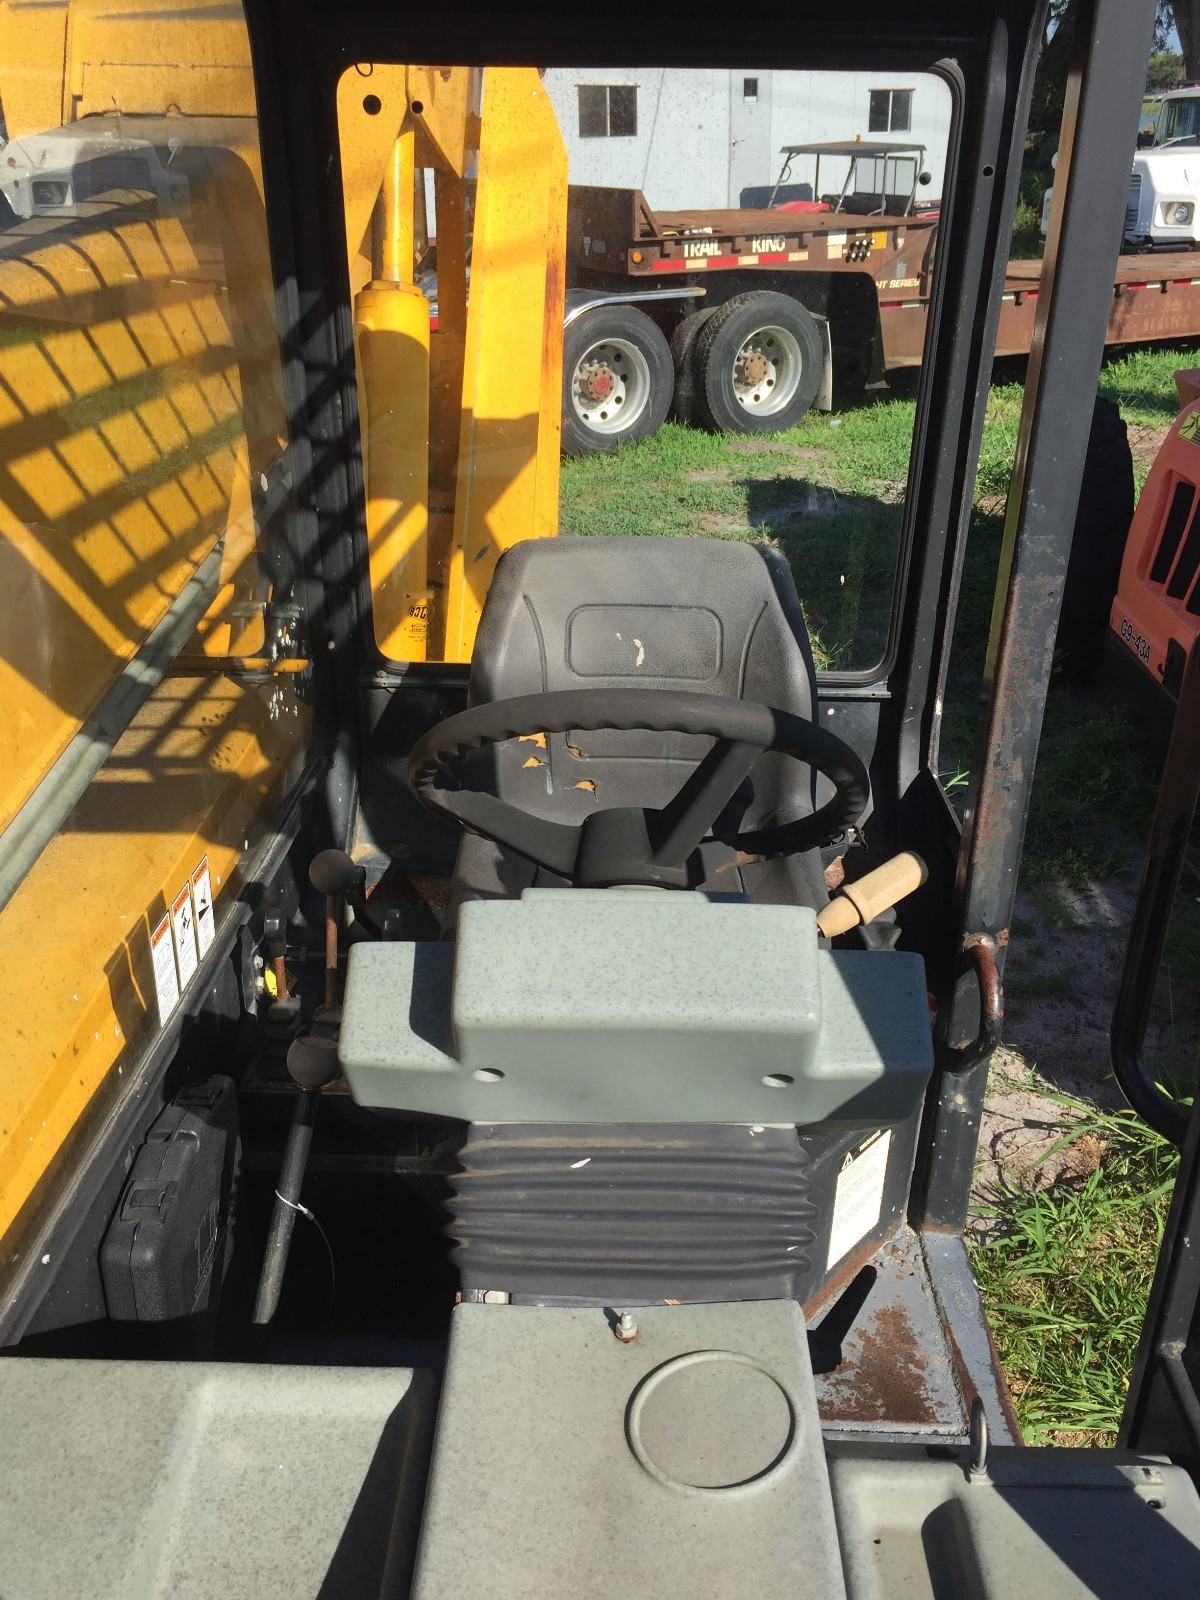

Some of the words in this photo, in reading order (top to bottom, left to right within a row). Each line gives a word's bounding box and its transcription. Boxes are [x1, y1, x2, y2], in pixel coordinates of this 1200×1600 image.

[682, 239, 722, 258] TRAIL
[752, 234, 786, 253] KING
[889, 278, 920, 288] SERIES
[408, 605, 427, 620] JCB
[1120, 618, 1151, 665] G9-43A
